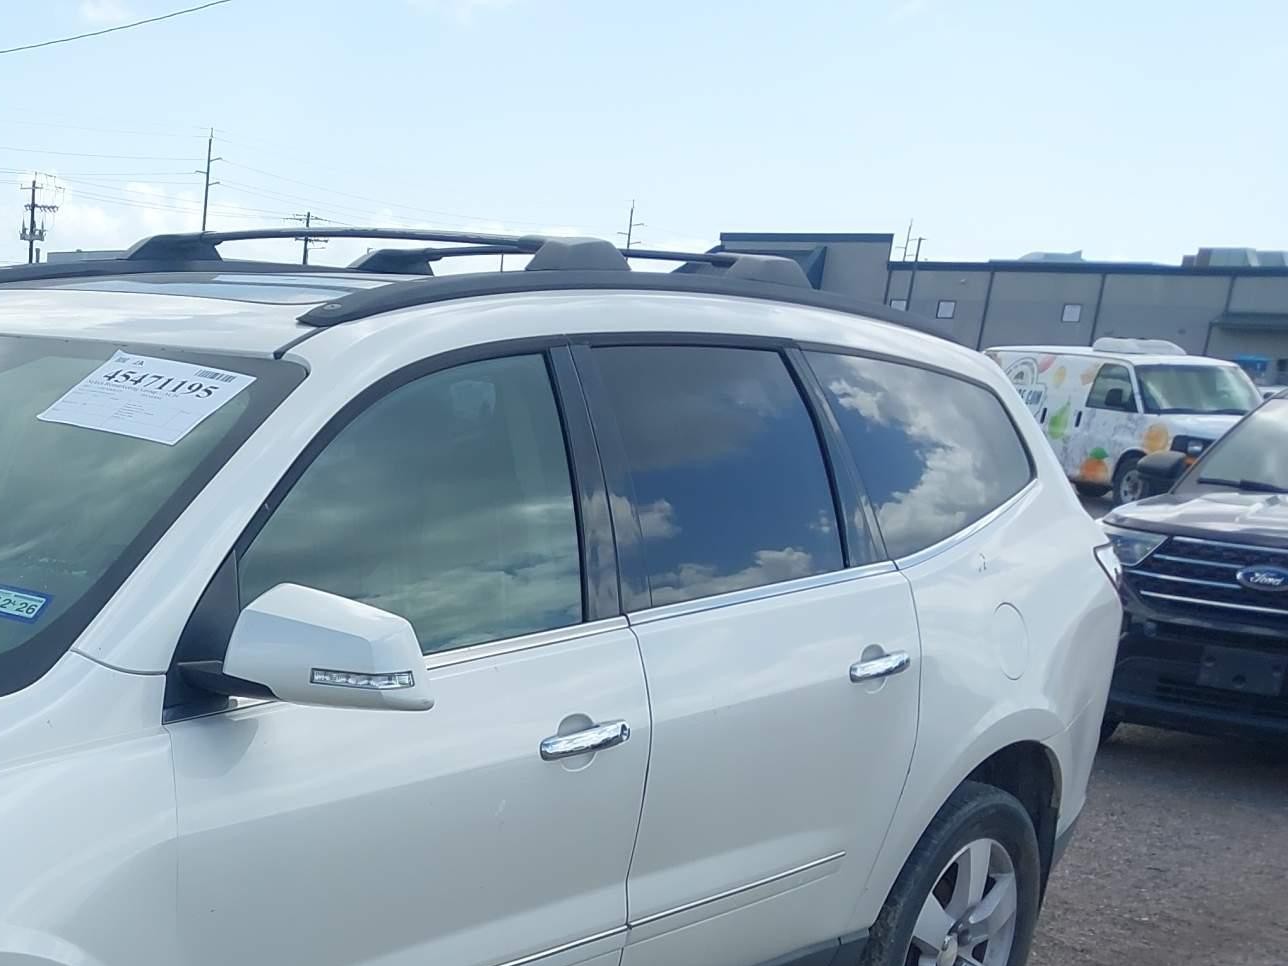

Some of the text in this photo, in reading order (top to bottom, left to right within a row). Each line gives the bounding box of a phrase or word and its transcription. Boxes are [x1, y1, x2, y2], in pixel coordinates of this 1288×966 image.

[103, 369, 219, 399] 45471195
[1250, 572, 1284, 585] Ford
[15, 602, 38, 615] 26
